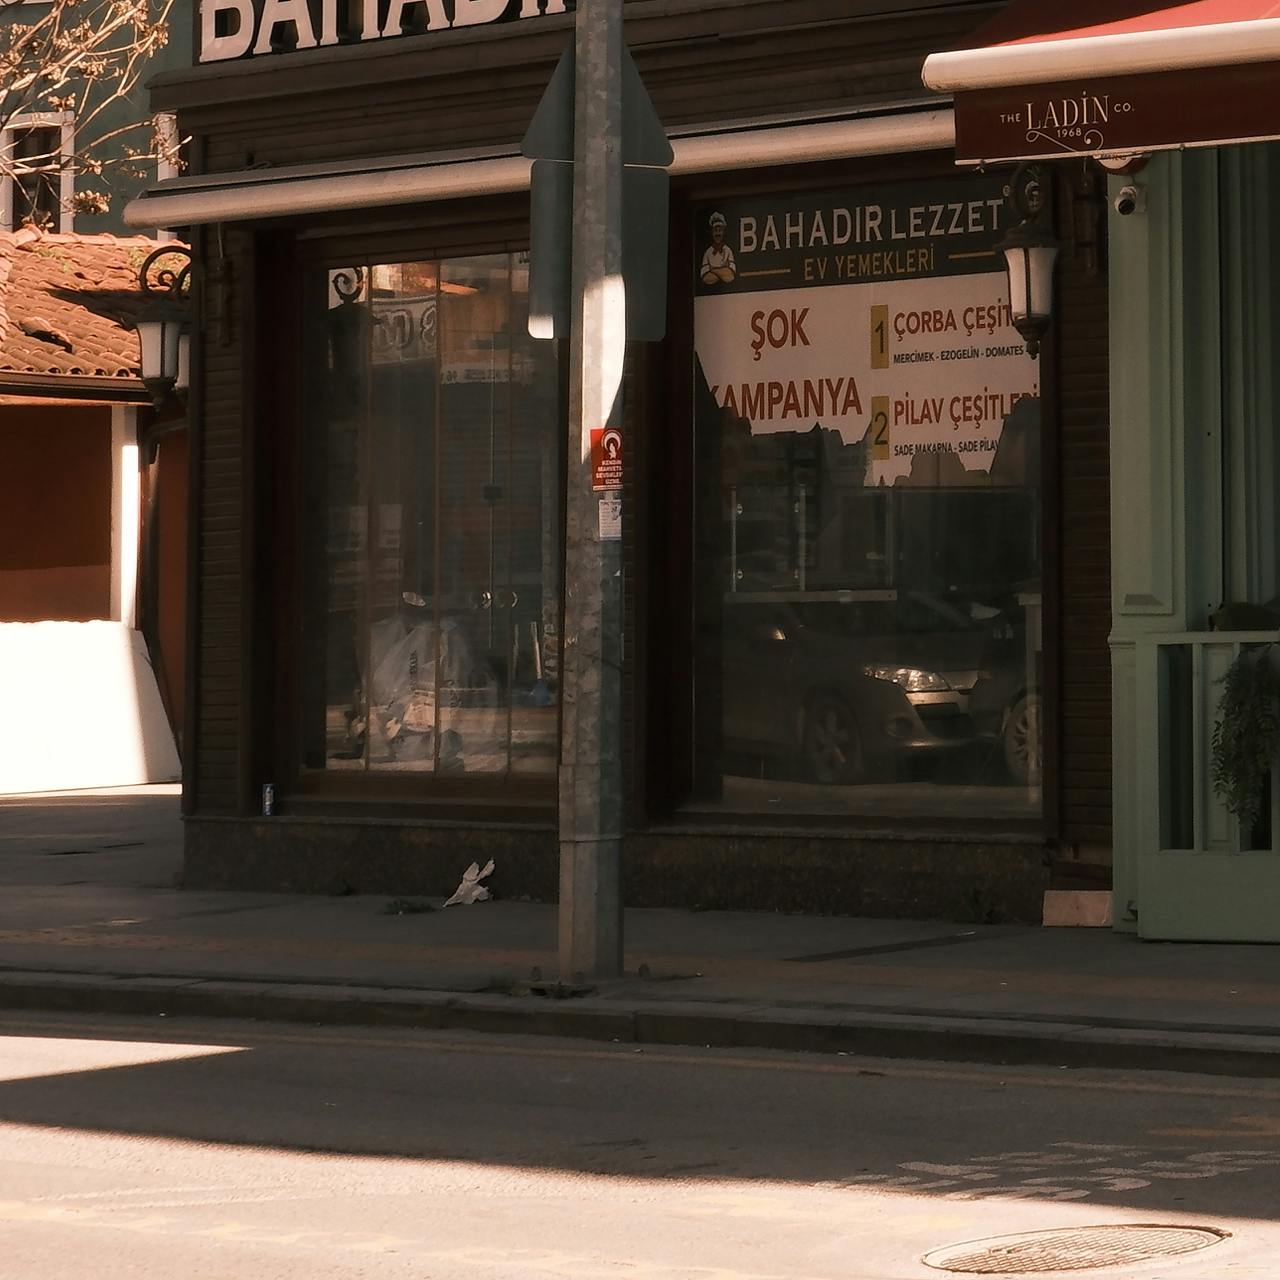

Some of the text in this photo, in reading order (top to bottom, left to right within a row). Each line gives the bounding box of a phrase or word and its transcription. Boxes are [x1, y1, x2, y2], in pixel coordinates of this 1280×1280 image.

[1000, 113, 1021, 123] THE
[1026, 91, 1110, 130] LADİN
[1057, 128, 1081, 138] 1968
[739, 199, 1004, 253] BAHADIR LEZZET
[804, 243, 935, 280] EV YEMEKLERİ
[751, 308, 810, 361] ŞOK
[875, 320, 884, 354] 1
[894, 298, 1014, 342] ÇORBA ÇEŞİT
[893, 349, 934, 364] MERCİMEK
[941, 346, 979, 360] EZOGELİN
[986, 345, 1024, 357] DOMATES
[710, 377, 862, 421] AMPANYA
[894, 383, 1038, 430] PİLAV ÇEŞİTL
[874, 412, 888, 445] 2
[894, 444, 914, 456] SADE
[959, 440, 978, 453] SADE
